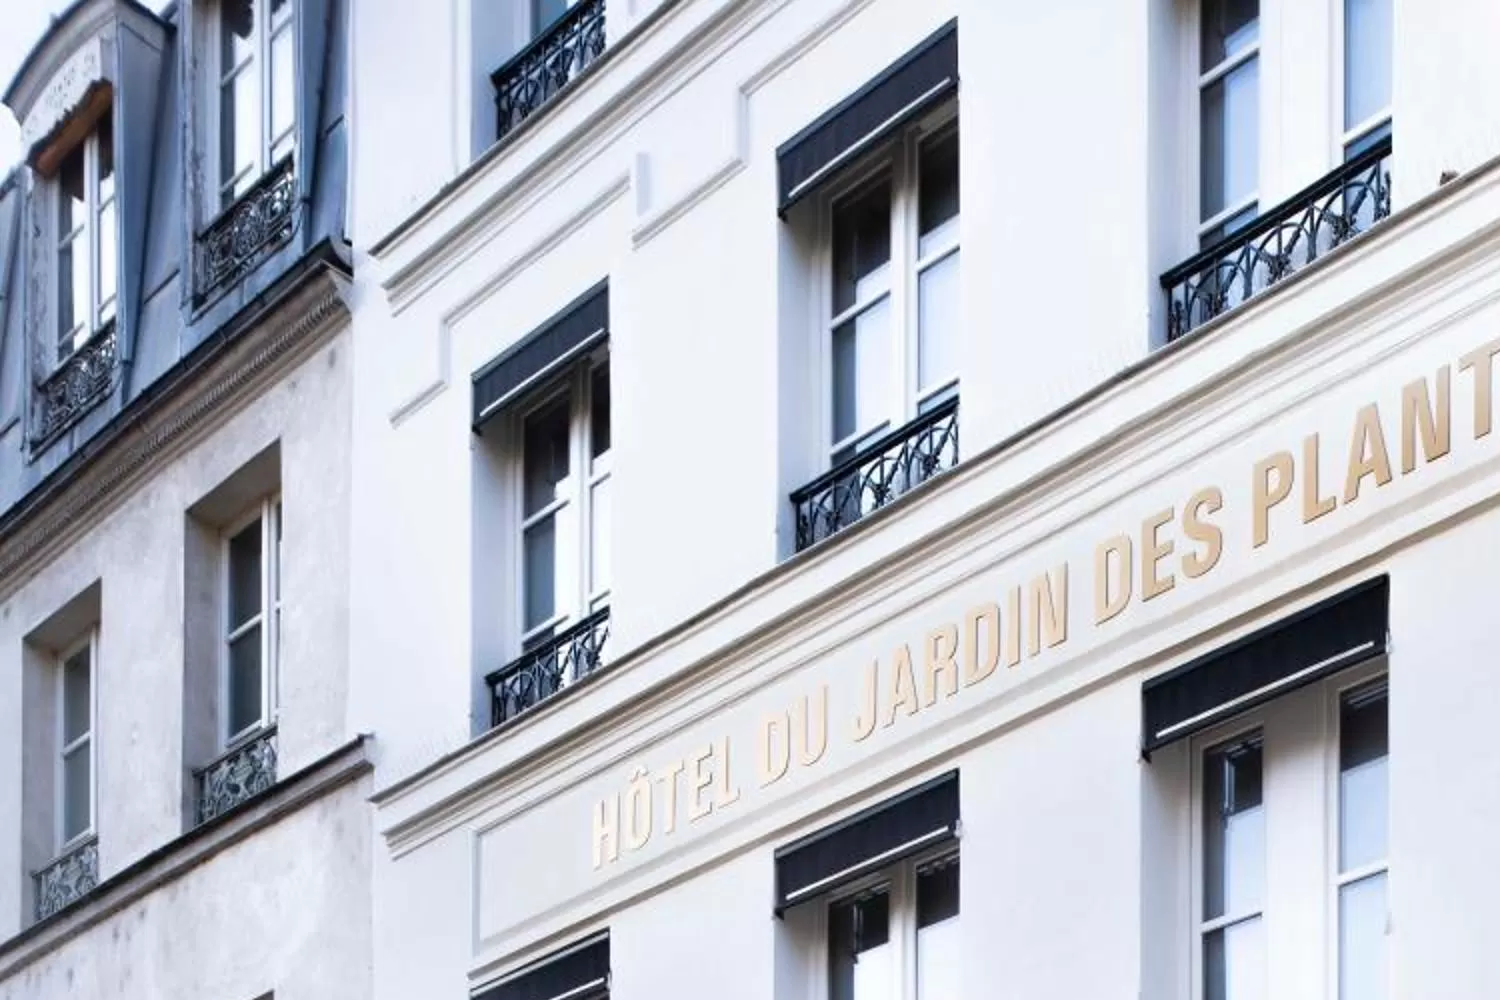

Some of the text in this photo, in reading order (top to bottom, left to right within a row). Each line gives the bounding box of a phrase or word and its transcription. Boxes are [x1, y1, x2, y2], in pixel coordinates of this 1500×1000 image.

[592, 735, 741, 870] HÔTEL
[756, 684, 829, 788] DU
[852, 561, 1068, 742] JARDIN
[1094, 486, 1223, 627] DES
